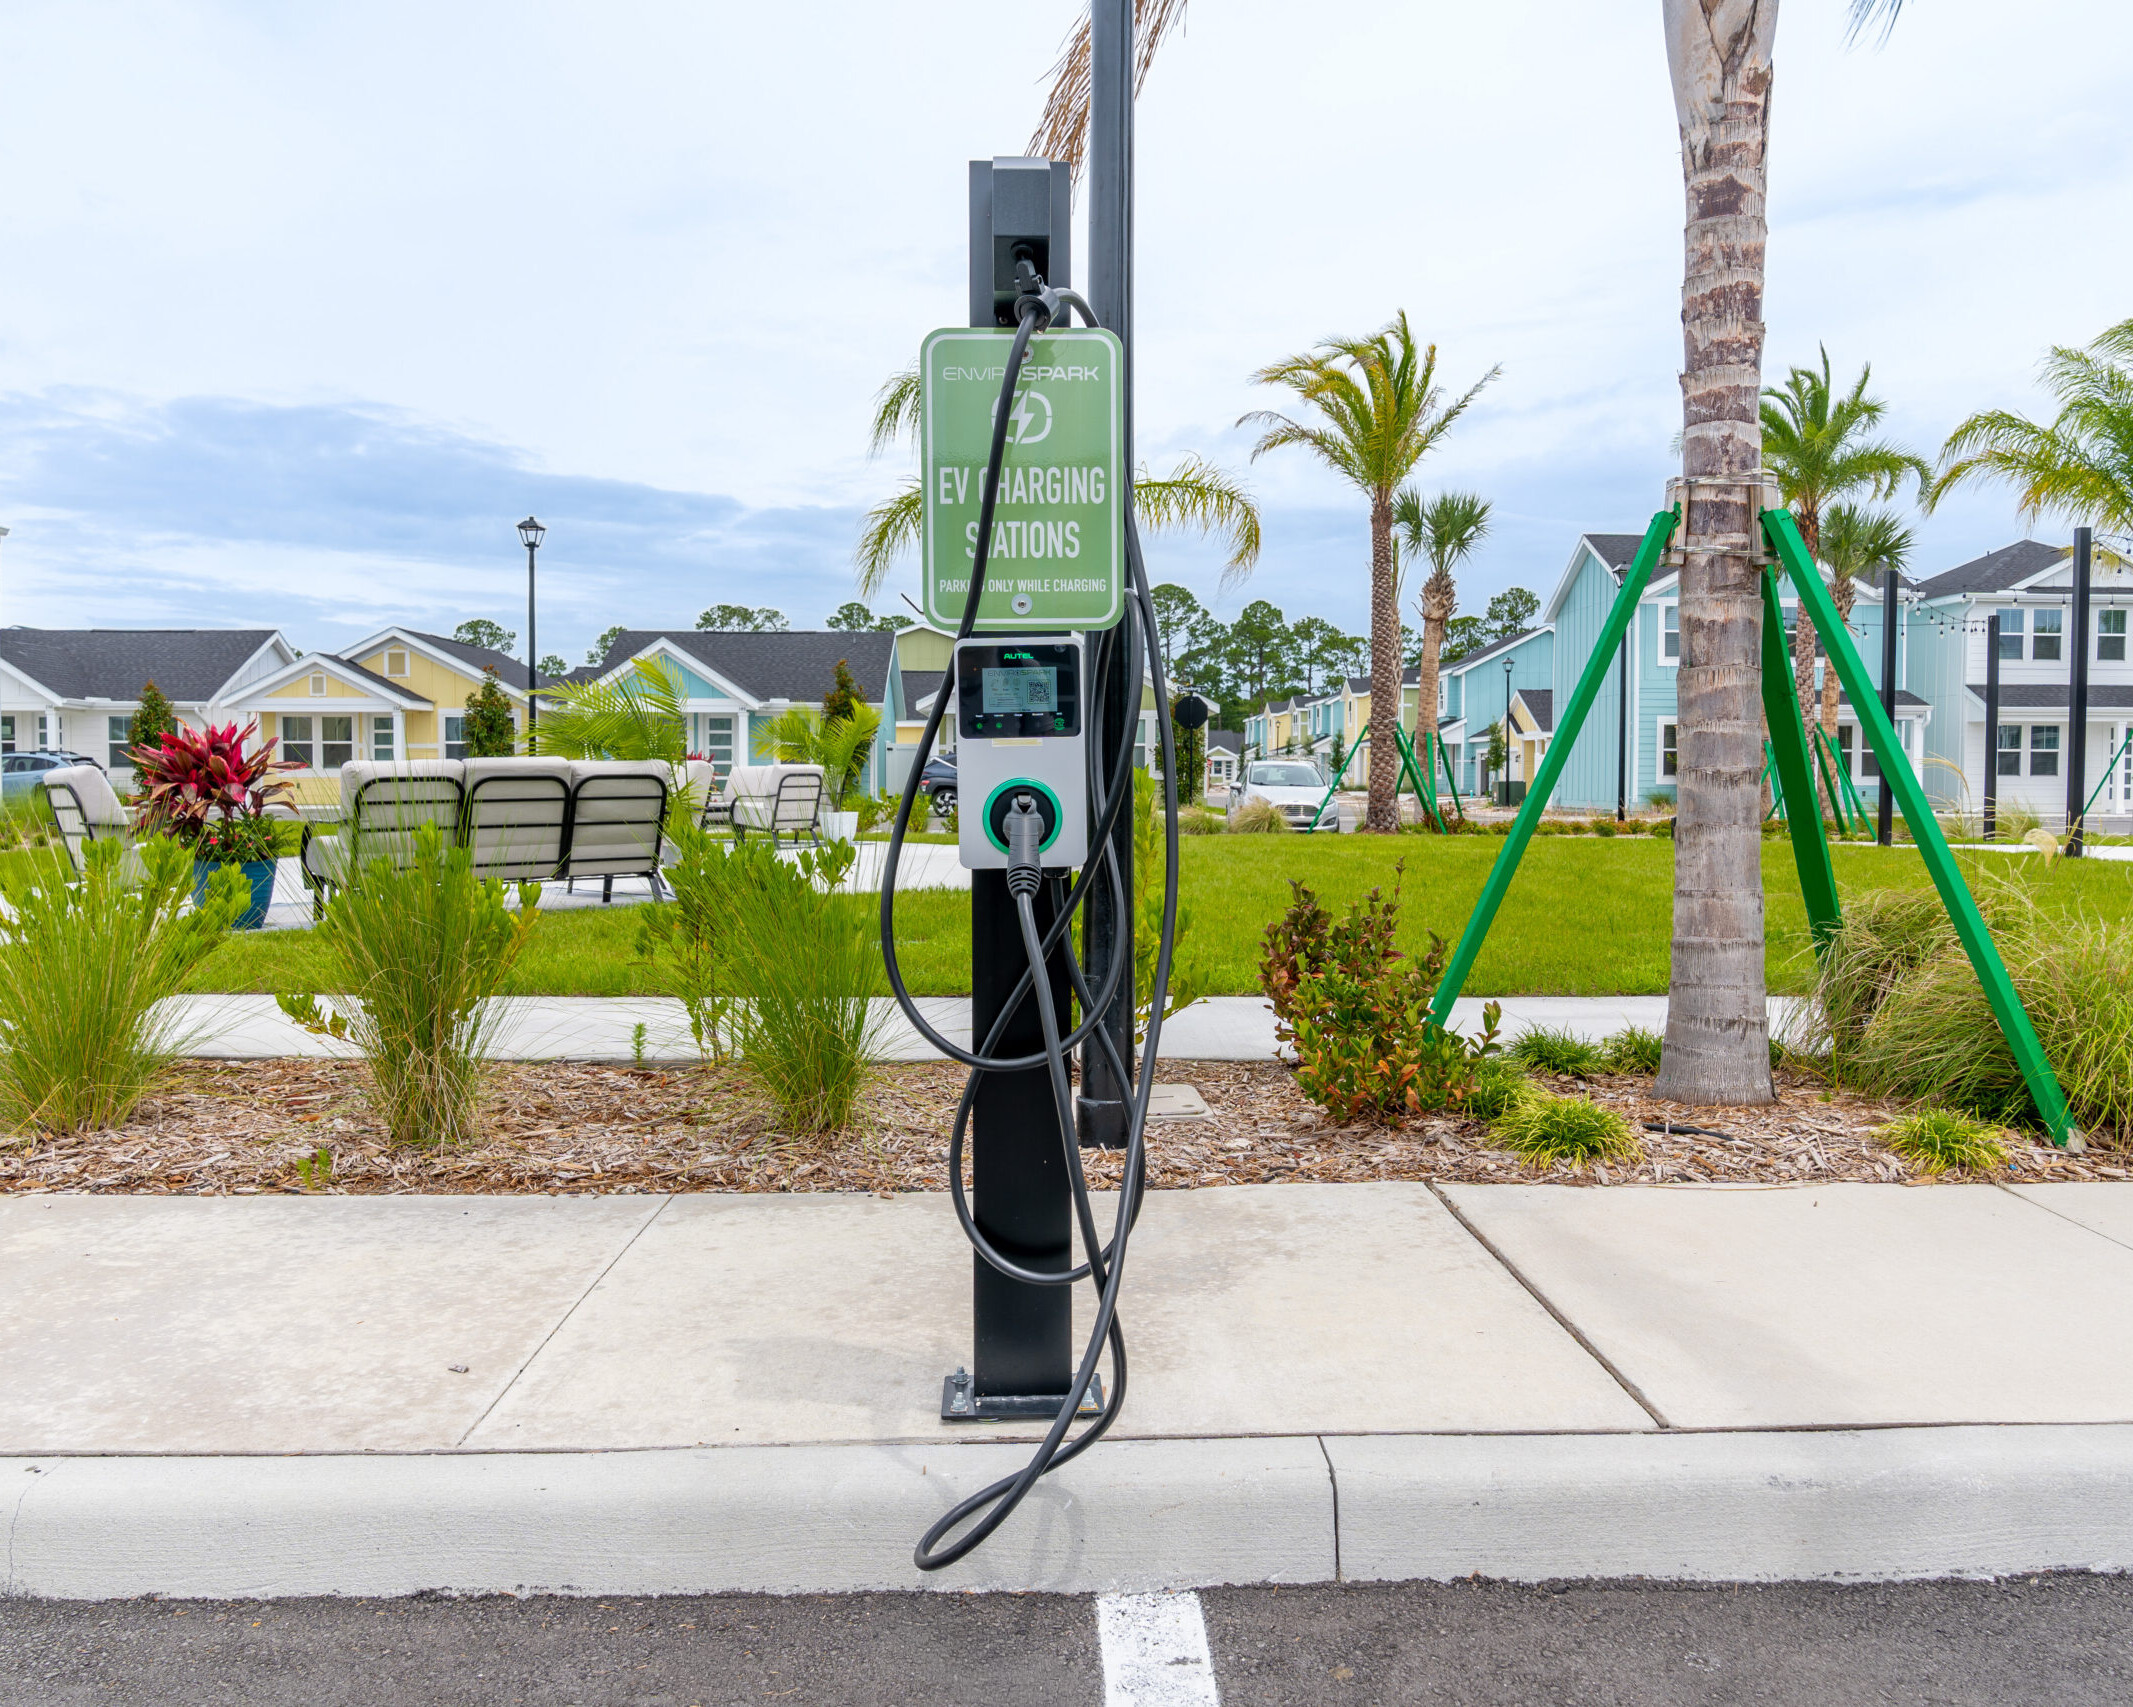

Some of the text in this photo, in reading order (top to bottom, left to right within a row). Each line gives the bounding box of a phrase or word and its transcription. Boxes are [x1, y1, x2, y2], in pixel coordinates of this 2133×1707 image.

[943, 366, 1100, 381] ENVIRSPARK
[939, 466, 1105, 505] EV CHARGING
[939, 578, 1106, 593] PARKI ONLY WHILE CHARGING
